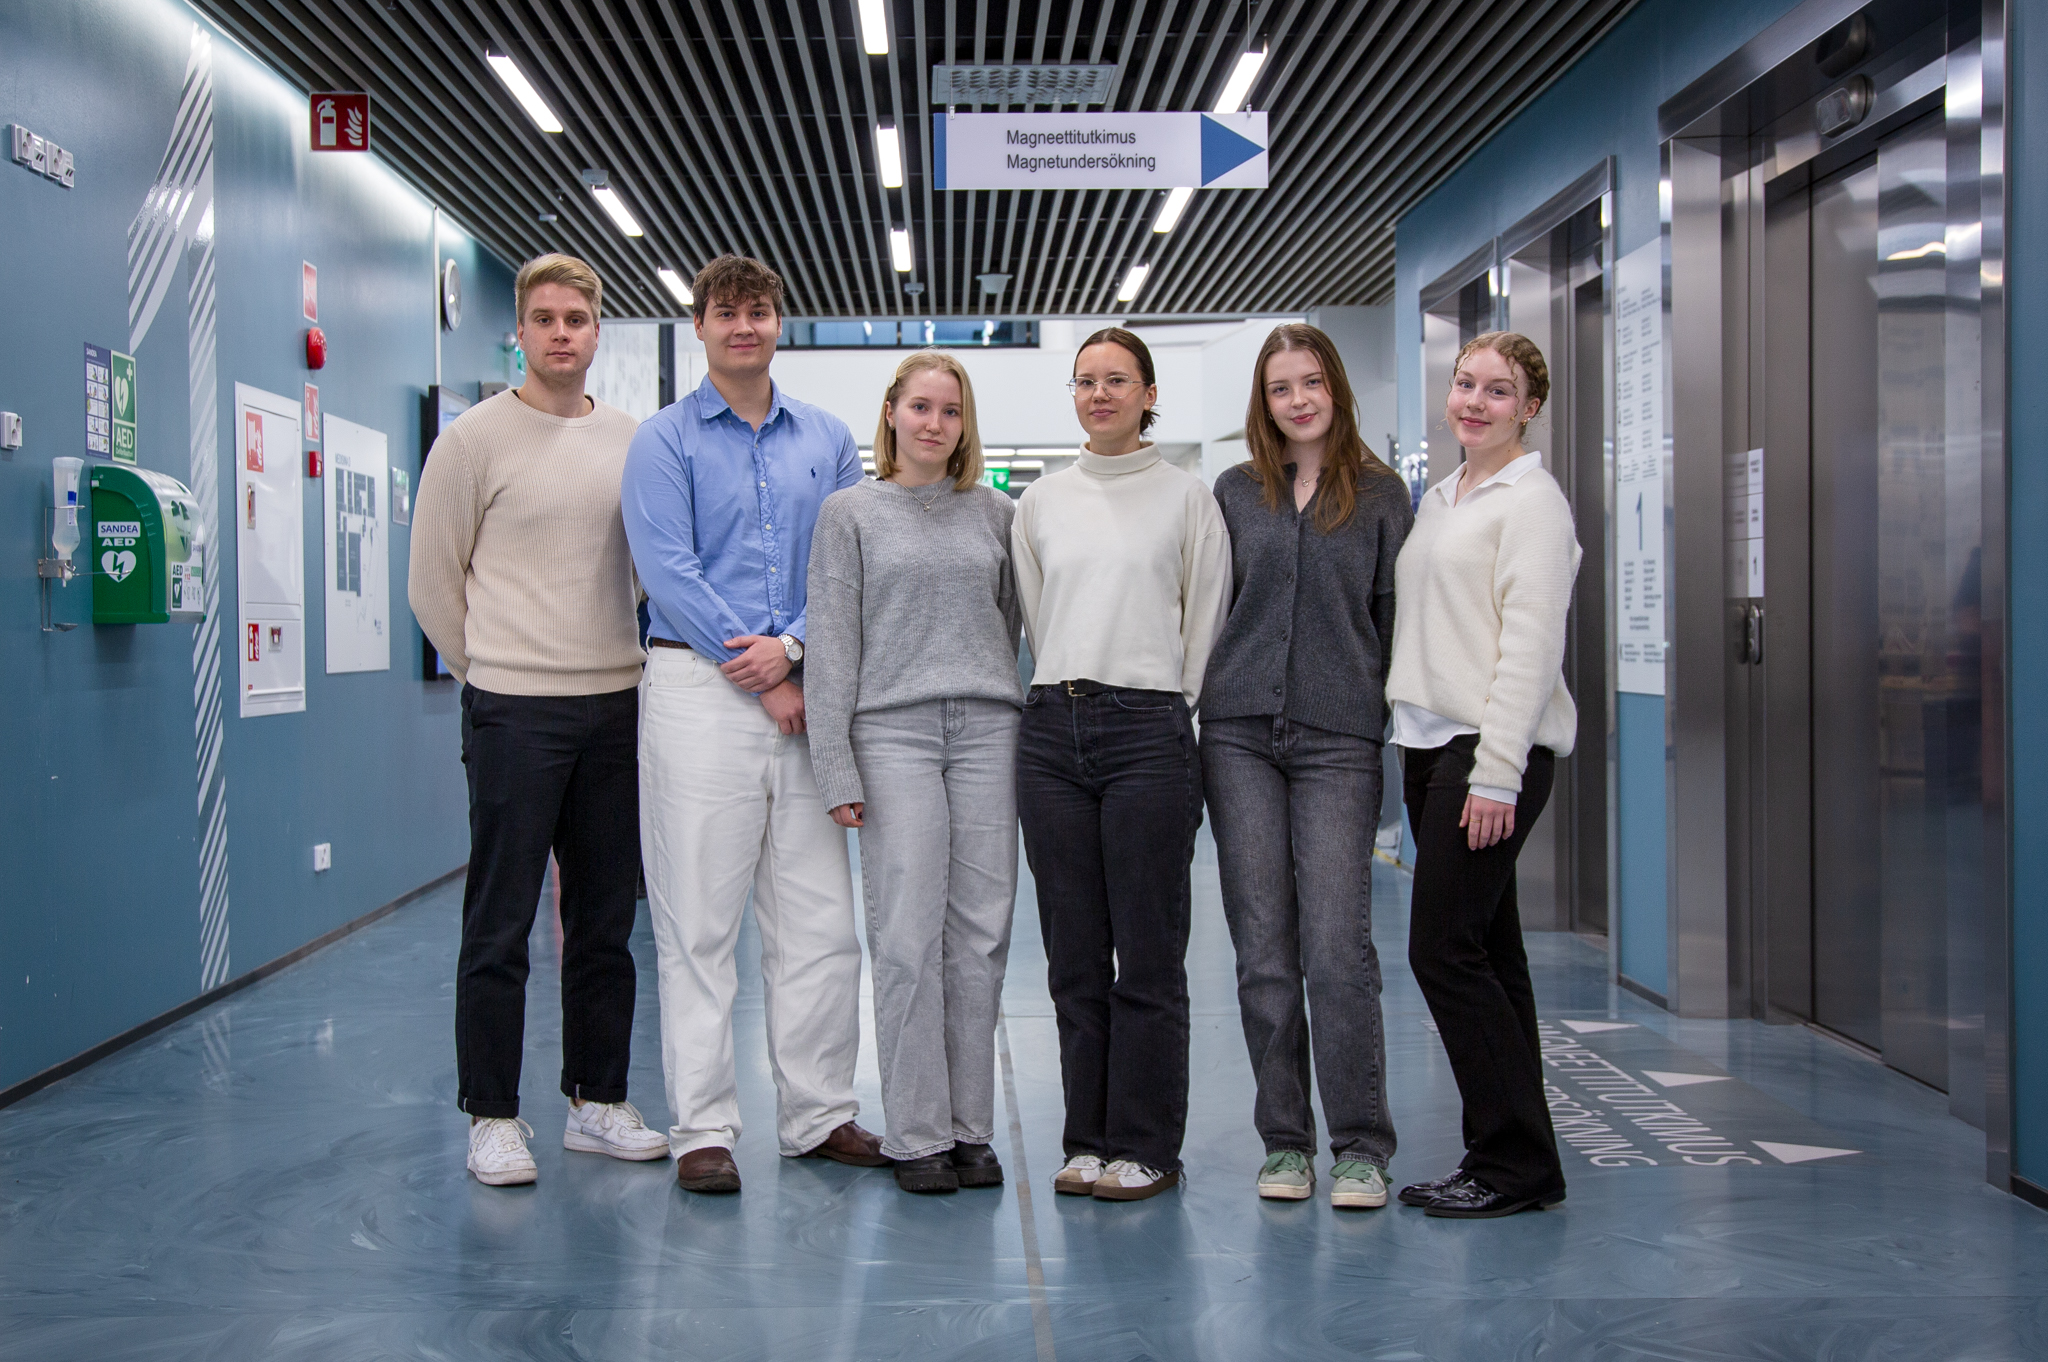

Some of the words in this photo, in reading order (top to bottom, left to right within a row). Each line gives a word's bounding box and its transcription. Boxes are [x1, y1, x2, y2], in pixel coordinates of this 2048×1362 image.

[1007, 129, 1136, 148] Magneettitutkimus
[1007, 153, 1156, 172] Magnetundersökning
[116, 426, 133, 449] AED
[101, 524, 138, 533] SANDEA
[102, 538, 136, 546] AED
[172, 564, 183, 576] AED
